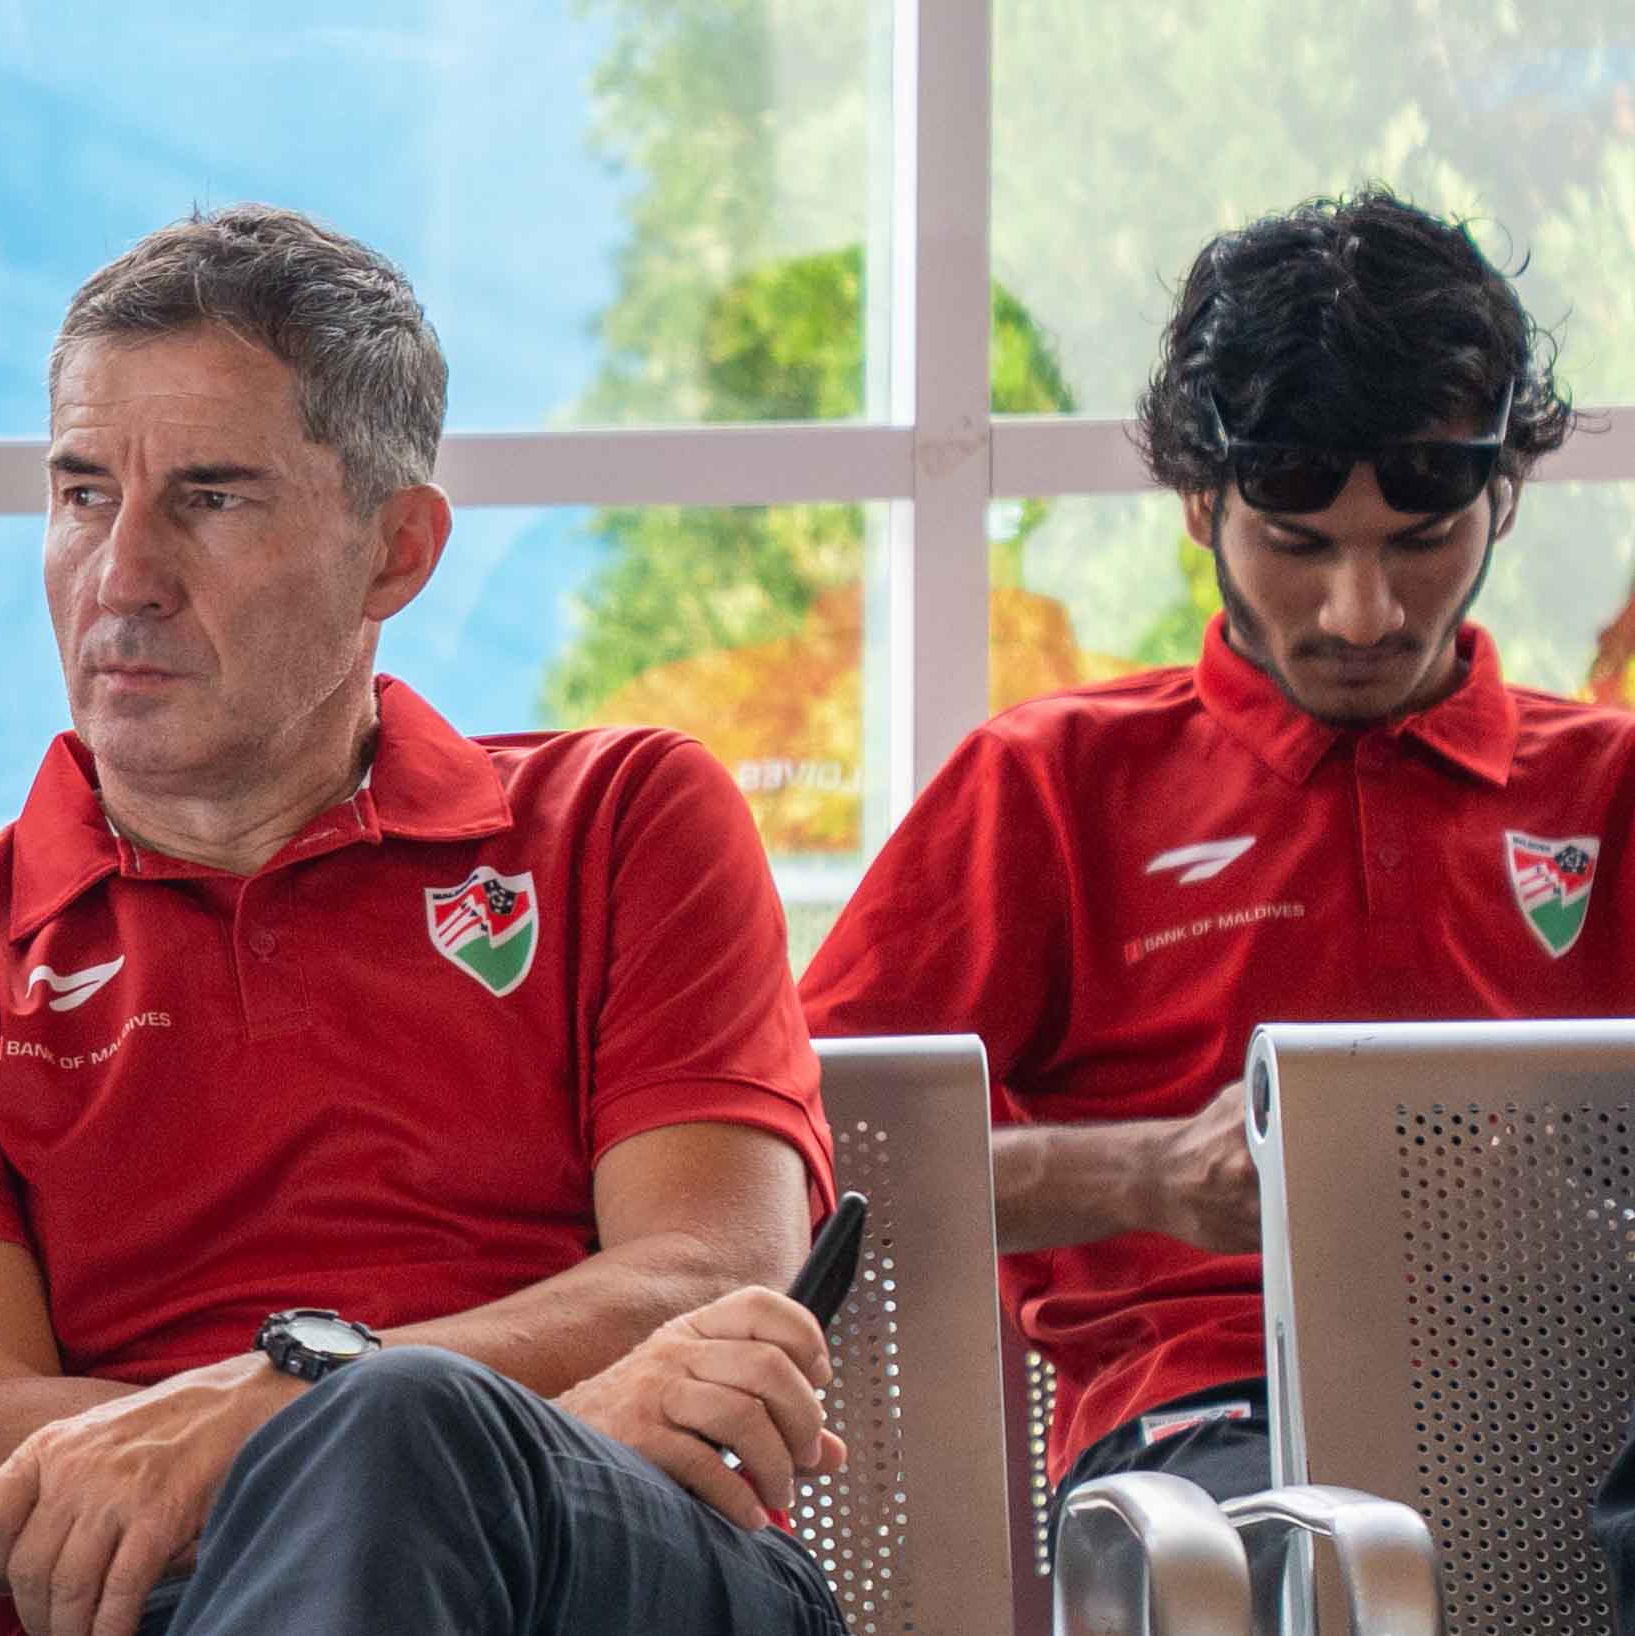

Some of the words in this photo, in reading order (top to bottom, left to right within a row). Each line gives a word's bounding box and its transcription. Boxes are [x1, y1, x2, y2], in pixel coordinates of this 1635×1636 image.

[1144, 928, 1188, 954] BANK
[1192, 920, 1214, 937] OF
[1218, 902, 1306, 930] MALDIVES
[60, 1056, 85, 1071] OF
